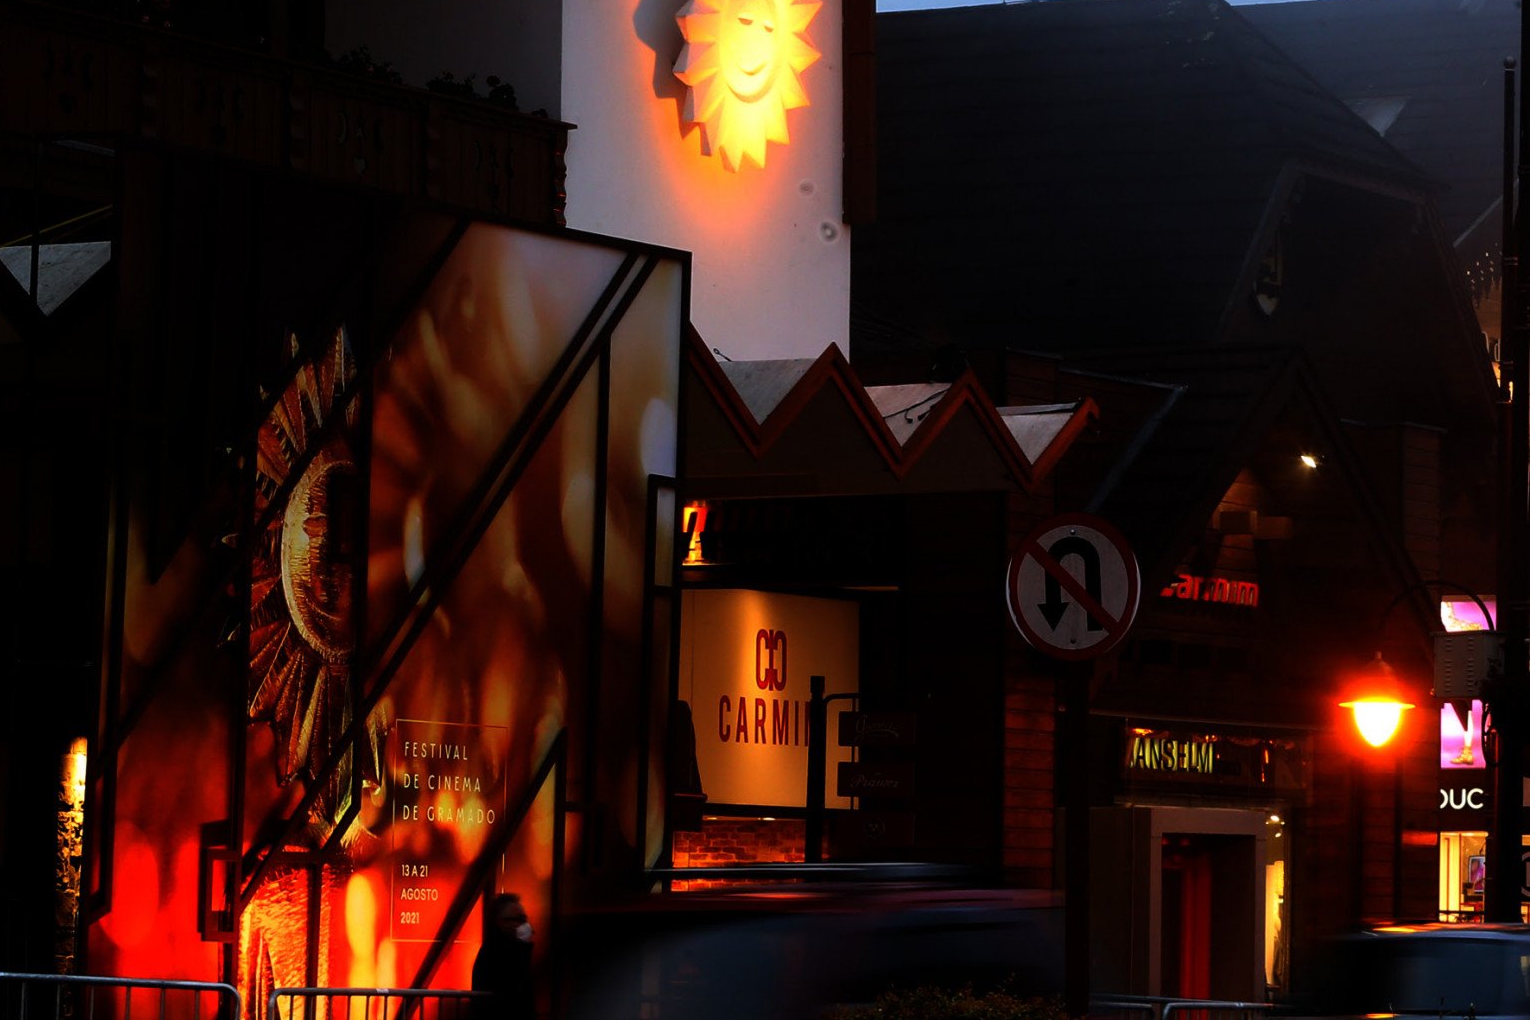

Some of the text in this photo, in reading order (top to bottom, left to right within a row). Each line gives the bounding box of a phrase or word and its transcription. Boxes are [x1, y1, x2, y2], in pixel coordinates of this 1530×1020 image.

[404, 741, 468, 761] FESTIVAL
[403, 773, 481, 792] DE CINEMA
[402, 805, 496, 825] DE GRAMADO
[401, 864, 429, 877] 13 A 21
[400, 888, 439, 901] AGOSTO
[400, 911, 420, 924] 2021
